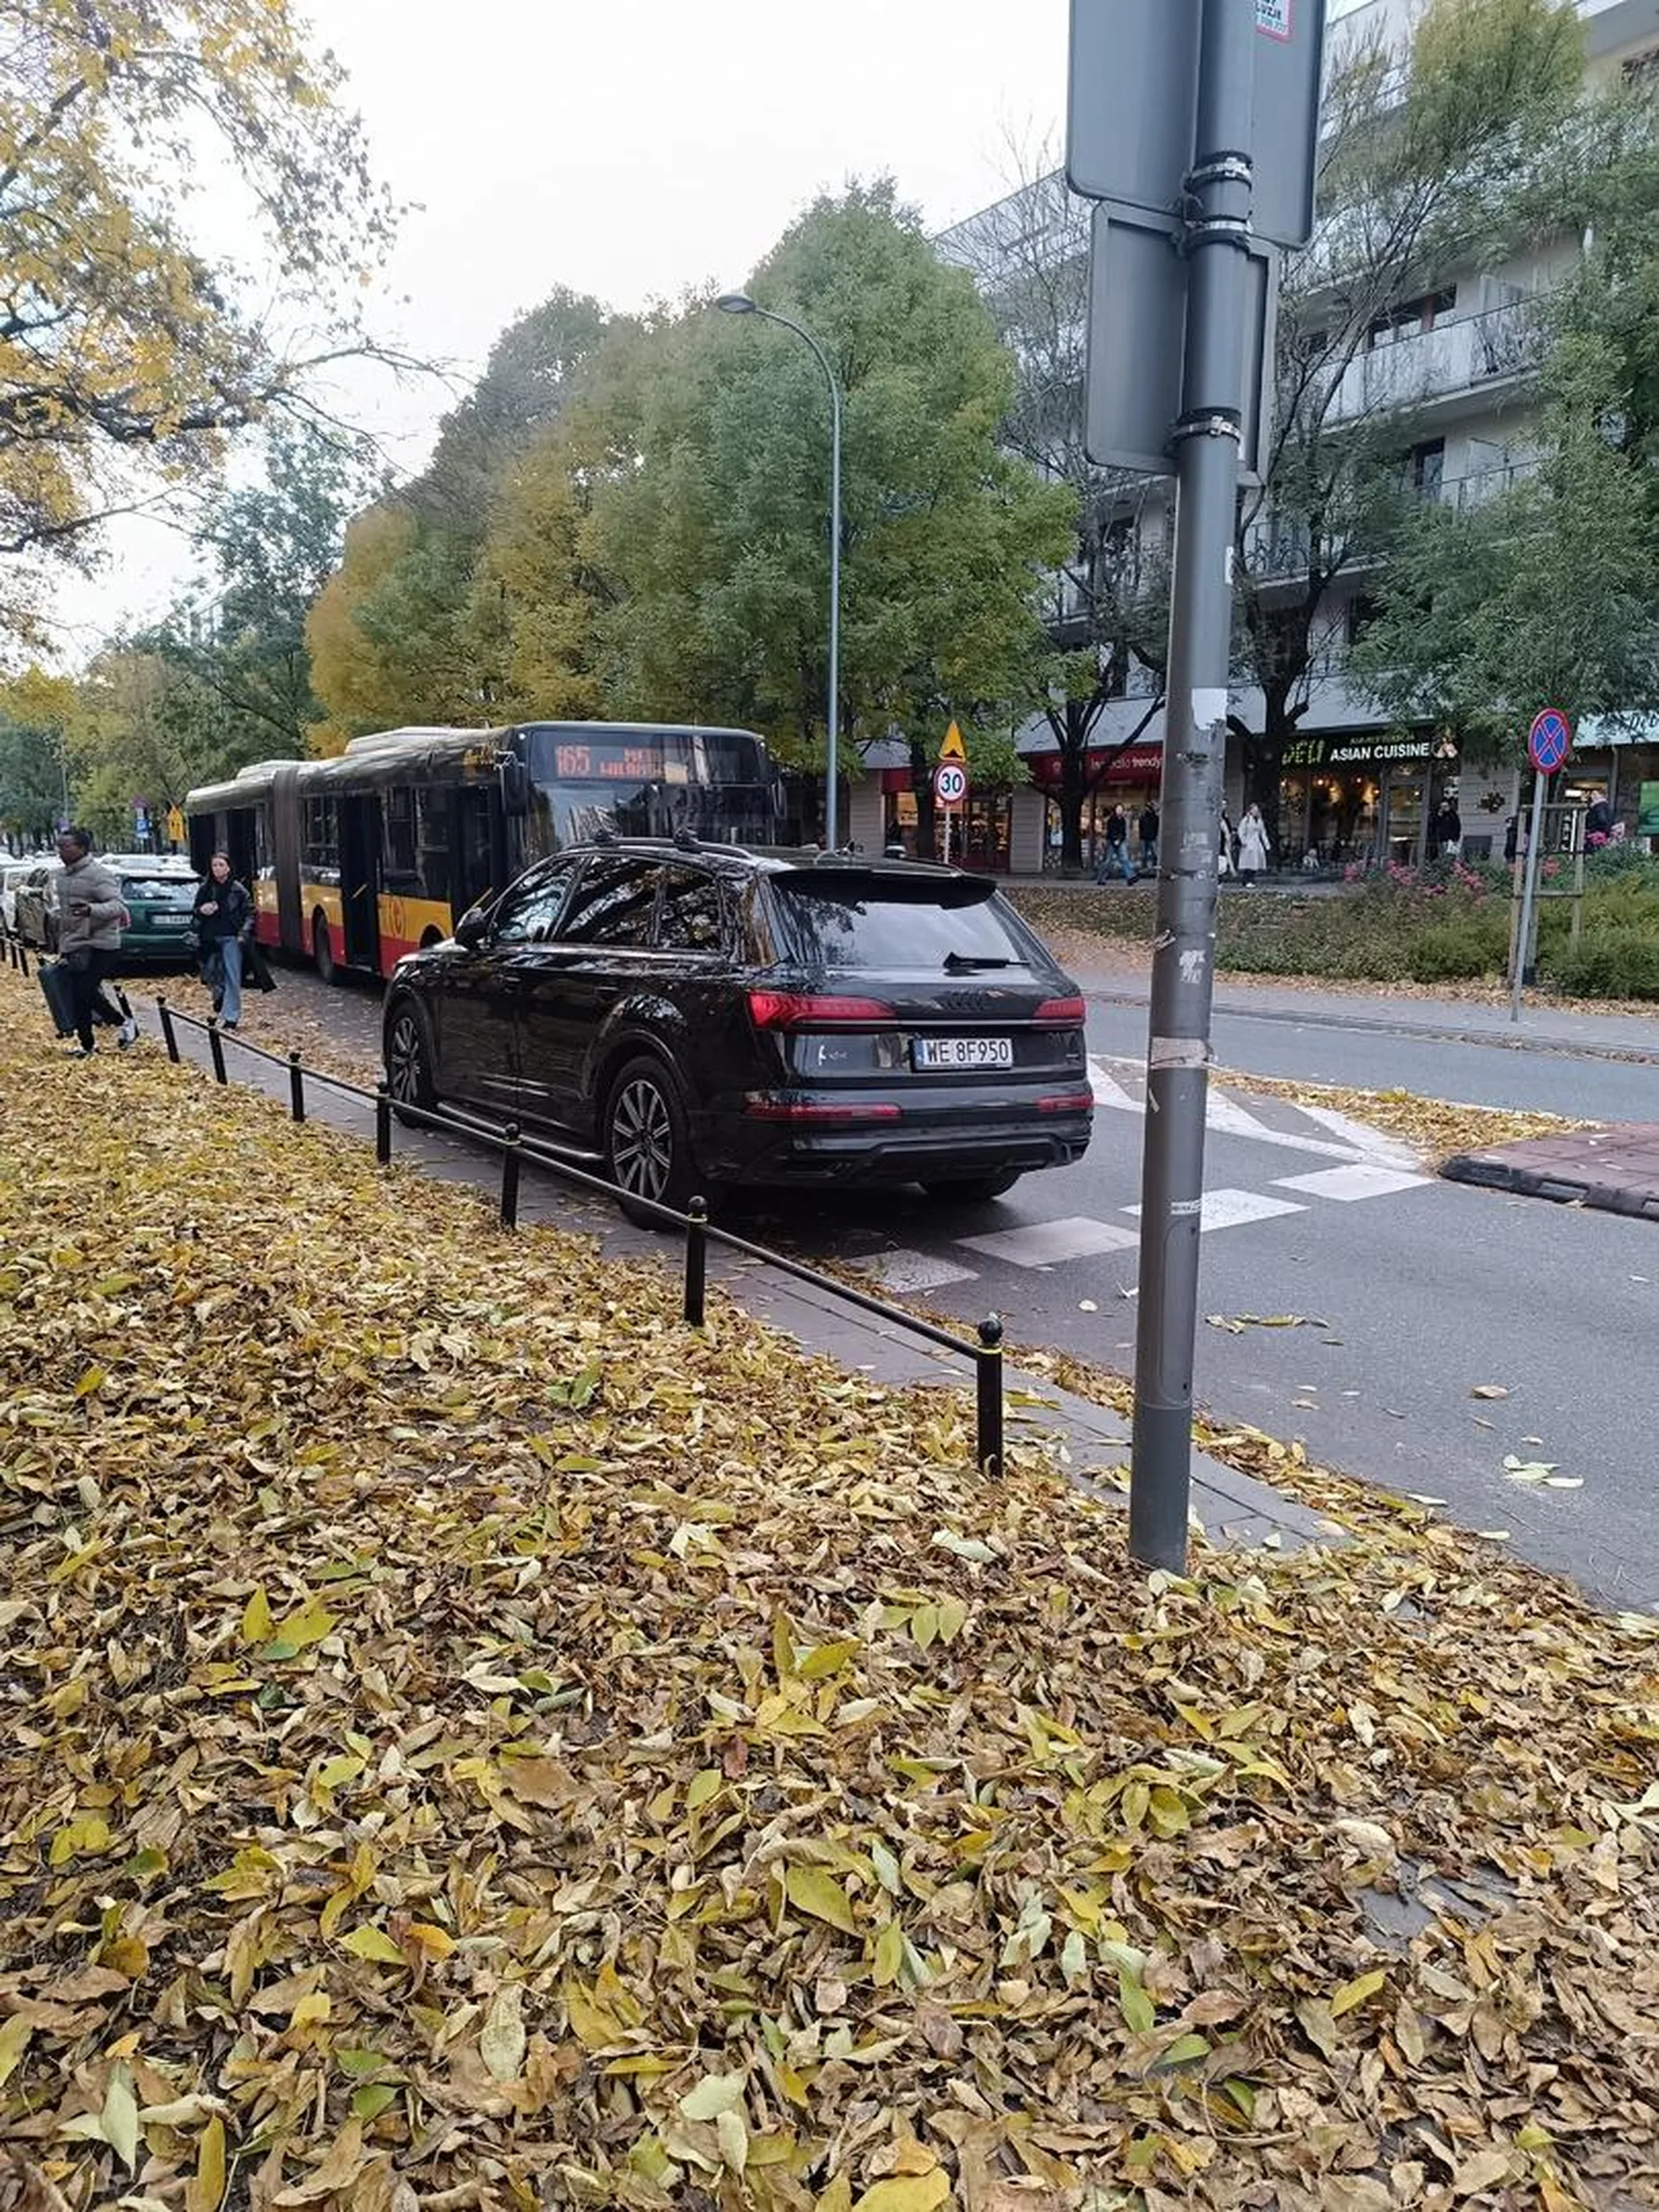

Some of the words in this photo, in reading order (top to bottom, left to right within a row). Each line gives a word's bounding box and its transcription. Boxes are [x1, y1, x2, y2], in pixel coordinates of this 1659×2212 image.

[557, 745, 590, 778] 165
[1330, 747, 1371, 762] ASIAN
[1373, 742, 1429, 758] CUISINE
[941, 772, 963, 793] 30
[928, 1041, 950, 1064] WE
[956, 1041, 1009, 1062] 8F950
